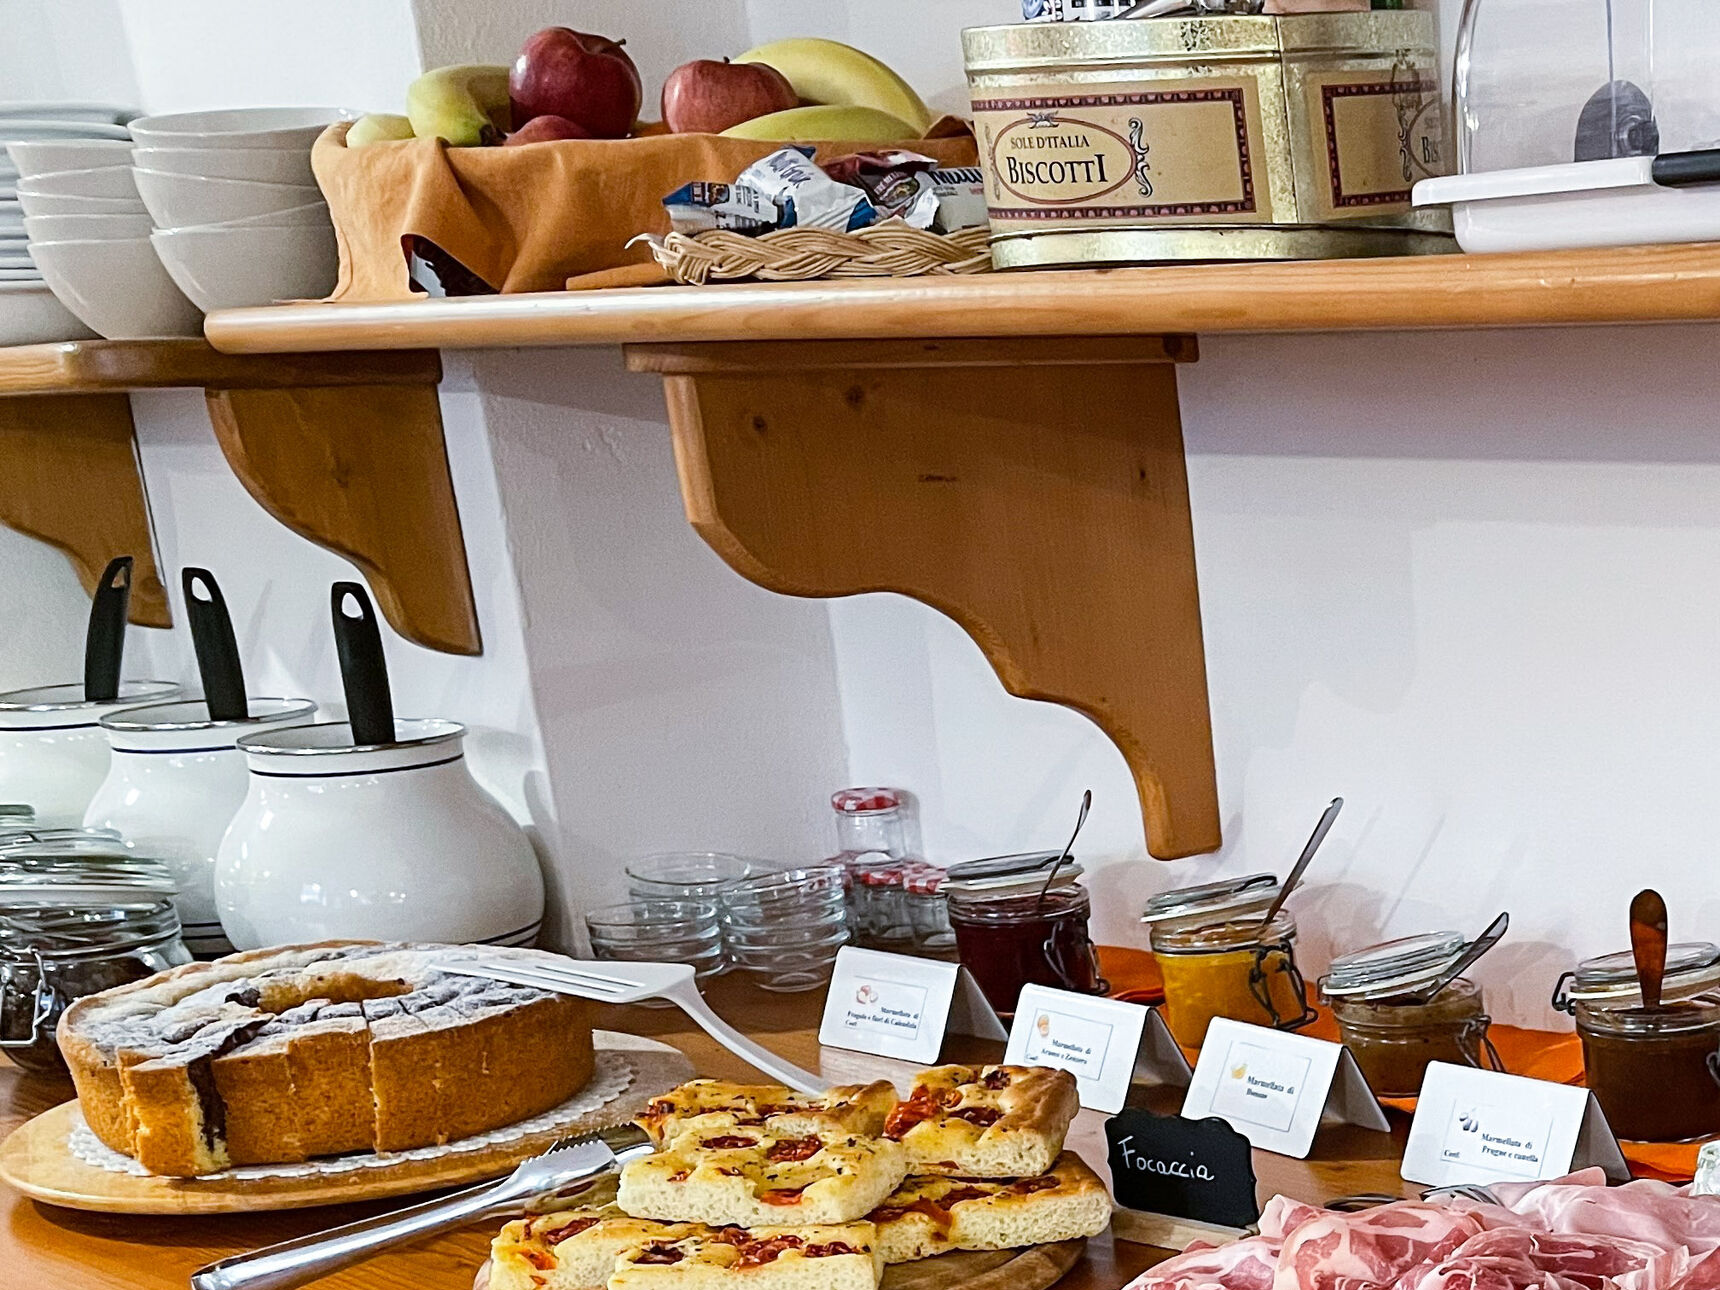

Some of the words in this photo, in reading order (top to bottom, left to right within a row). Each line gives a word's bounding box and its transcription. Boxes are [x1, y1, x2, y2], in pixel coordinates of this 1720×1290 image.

[1010, 136, 1035, 150] SOLE
[1036, 134, 1090, 149] D'ITALIA
[1005, 153, 1109, 184] BISCOTTI
[1117, 1135, 1215, 1181] Focaccia
